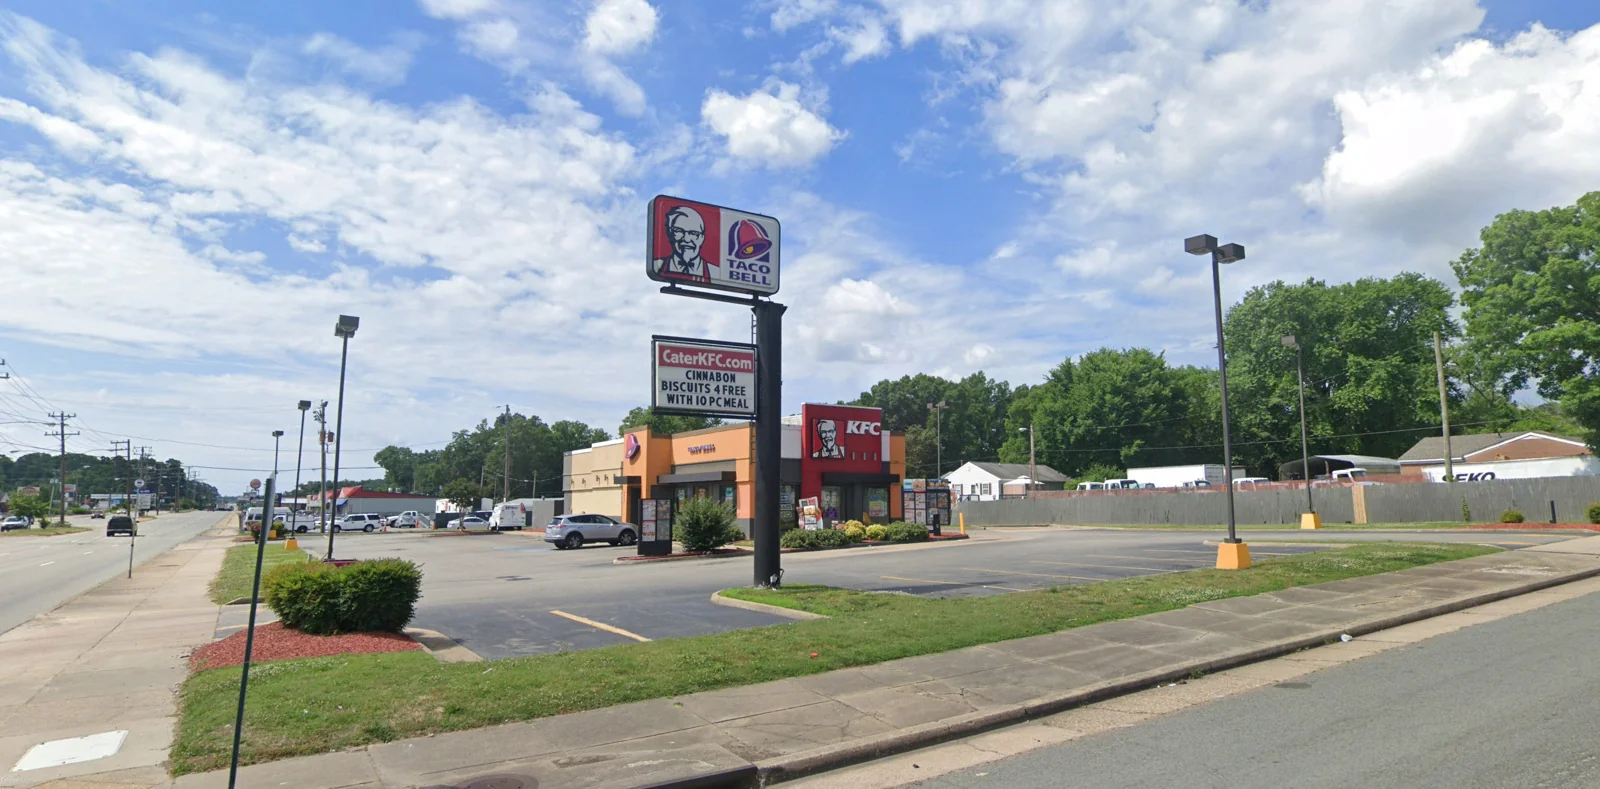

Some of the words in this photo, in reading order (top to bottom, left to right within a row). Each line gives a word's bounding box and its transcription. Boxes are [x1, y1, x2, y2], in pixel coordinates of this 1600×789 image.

[726, 258, 771, 274] TACO
[728, 270, 771, 286] BELL
[662, 349, 752, 370] CaterKFC.com
[685, 370, 736, 383] CINNABON
[661, 381, 711, 394] BISCUITS
[713, 385, 721, 395] 4
[722, 385, 746, 396] FREE
[666, 394, 693, 405] WITH
[845, 420, 881, 436] KFC
